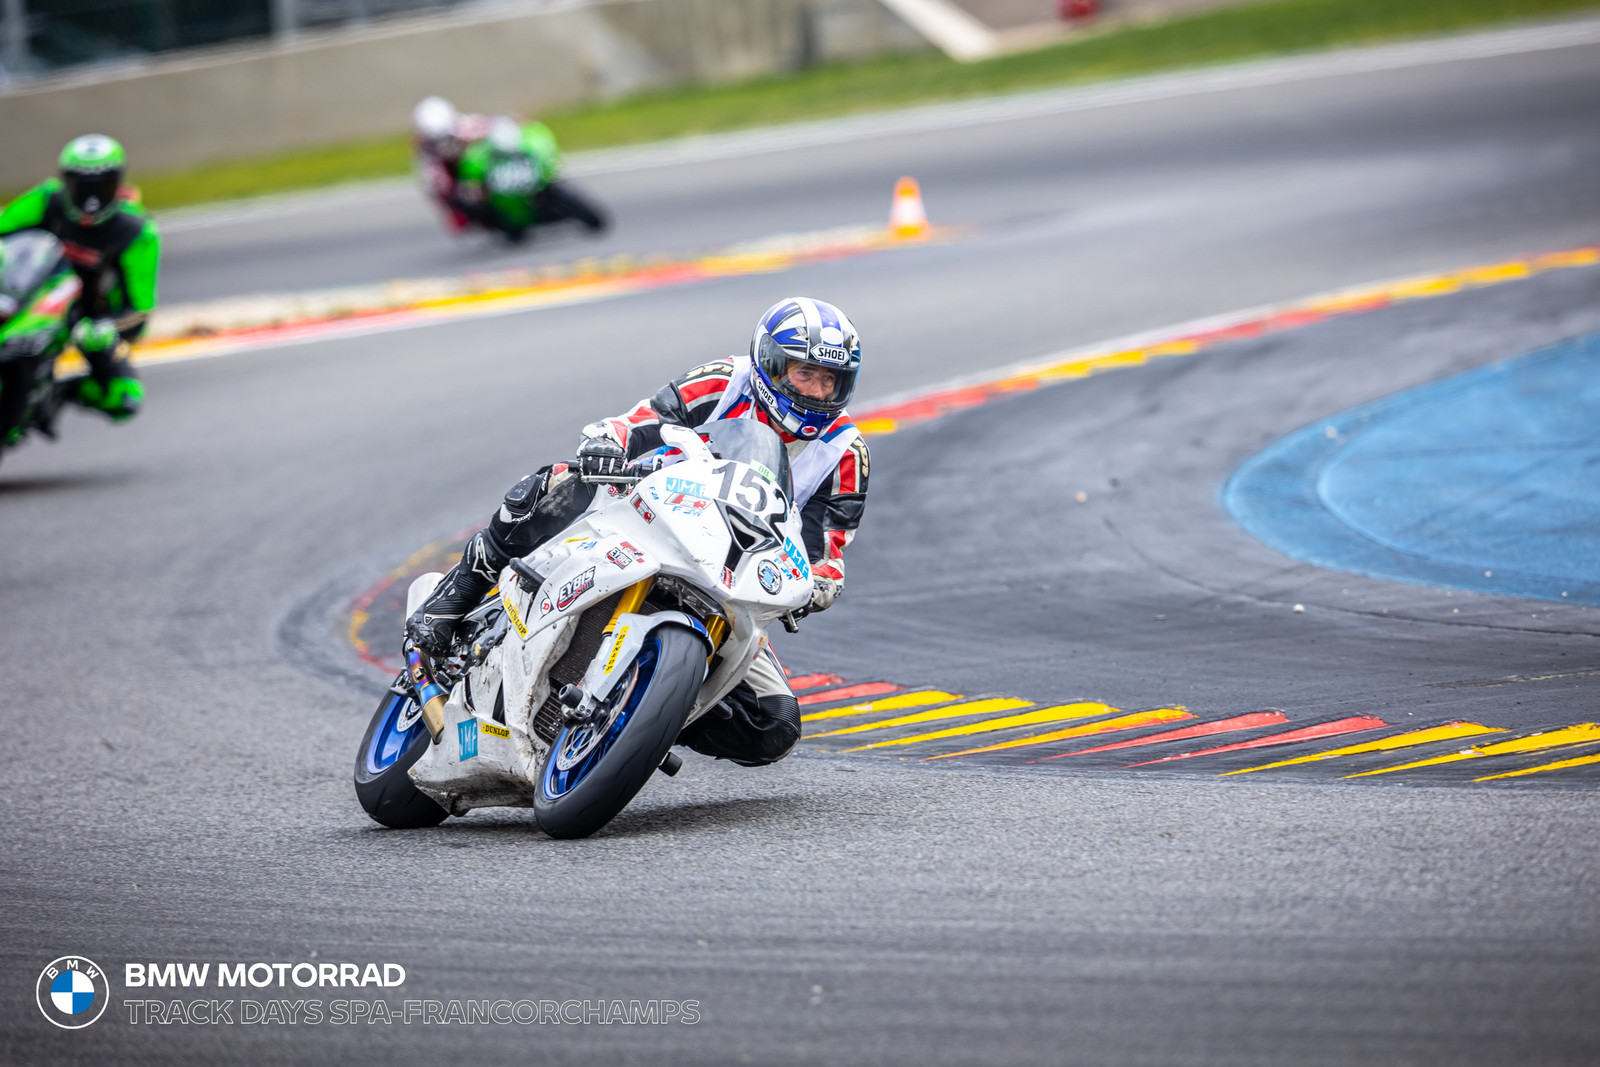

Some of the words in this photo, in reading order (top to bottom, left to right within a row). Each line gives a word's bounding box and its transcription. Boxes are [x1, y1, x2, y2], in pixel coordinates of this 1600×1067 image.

[818, 347, 845, 361] SHOEI
[757, 381, 775, 405] SHOEI
[559, 568, 595, 600] EYBIS
[507, 604, 527, 635] DUNLOP
[484, 724, 510, 737] DUNLOP
